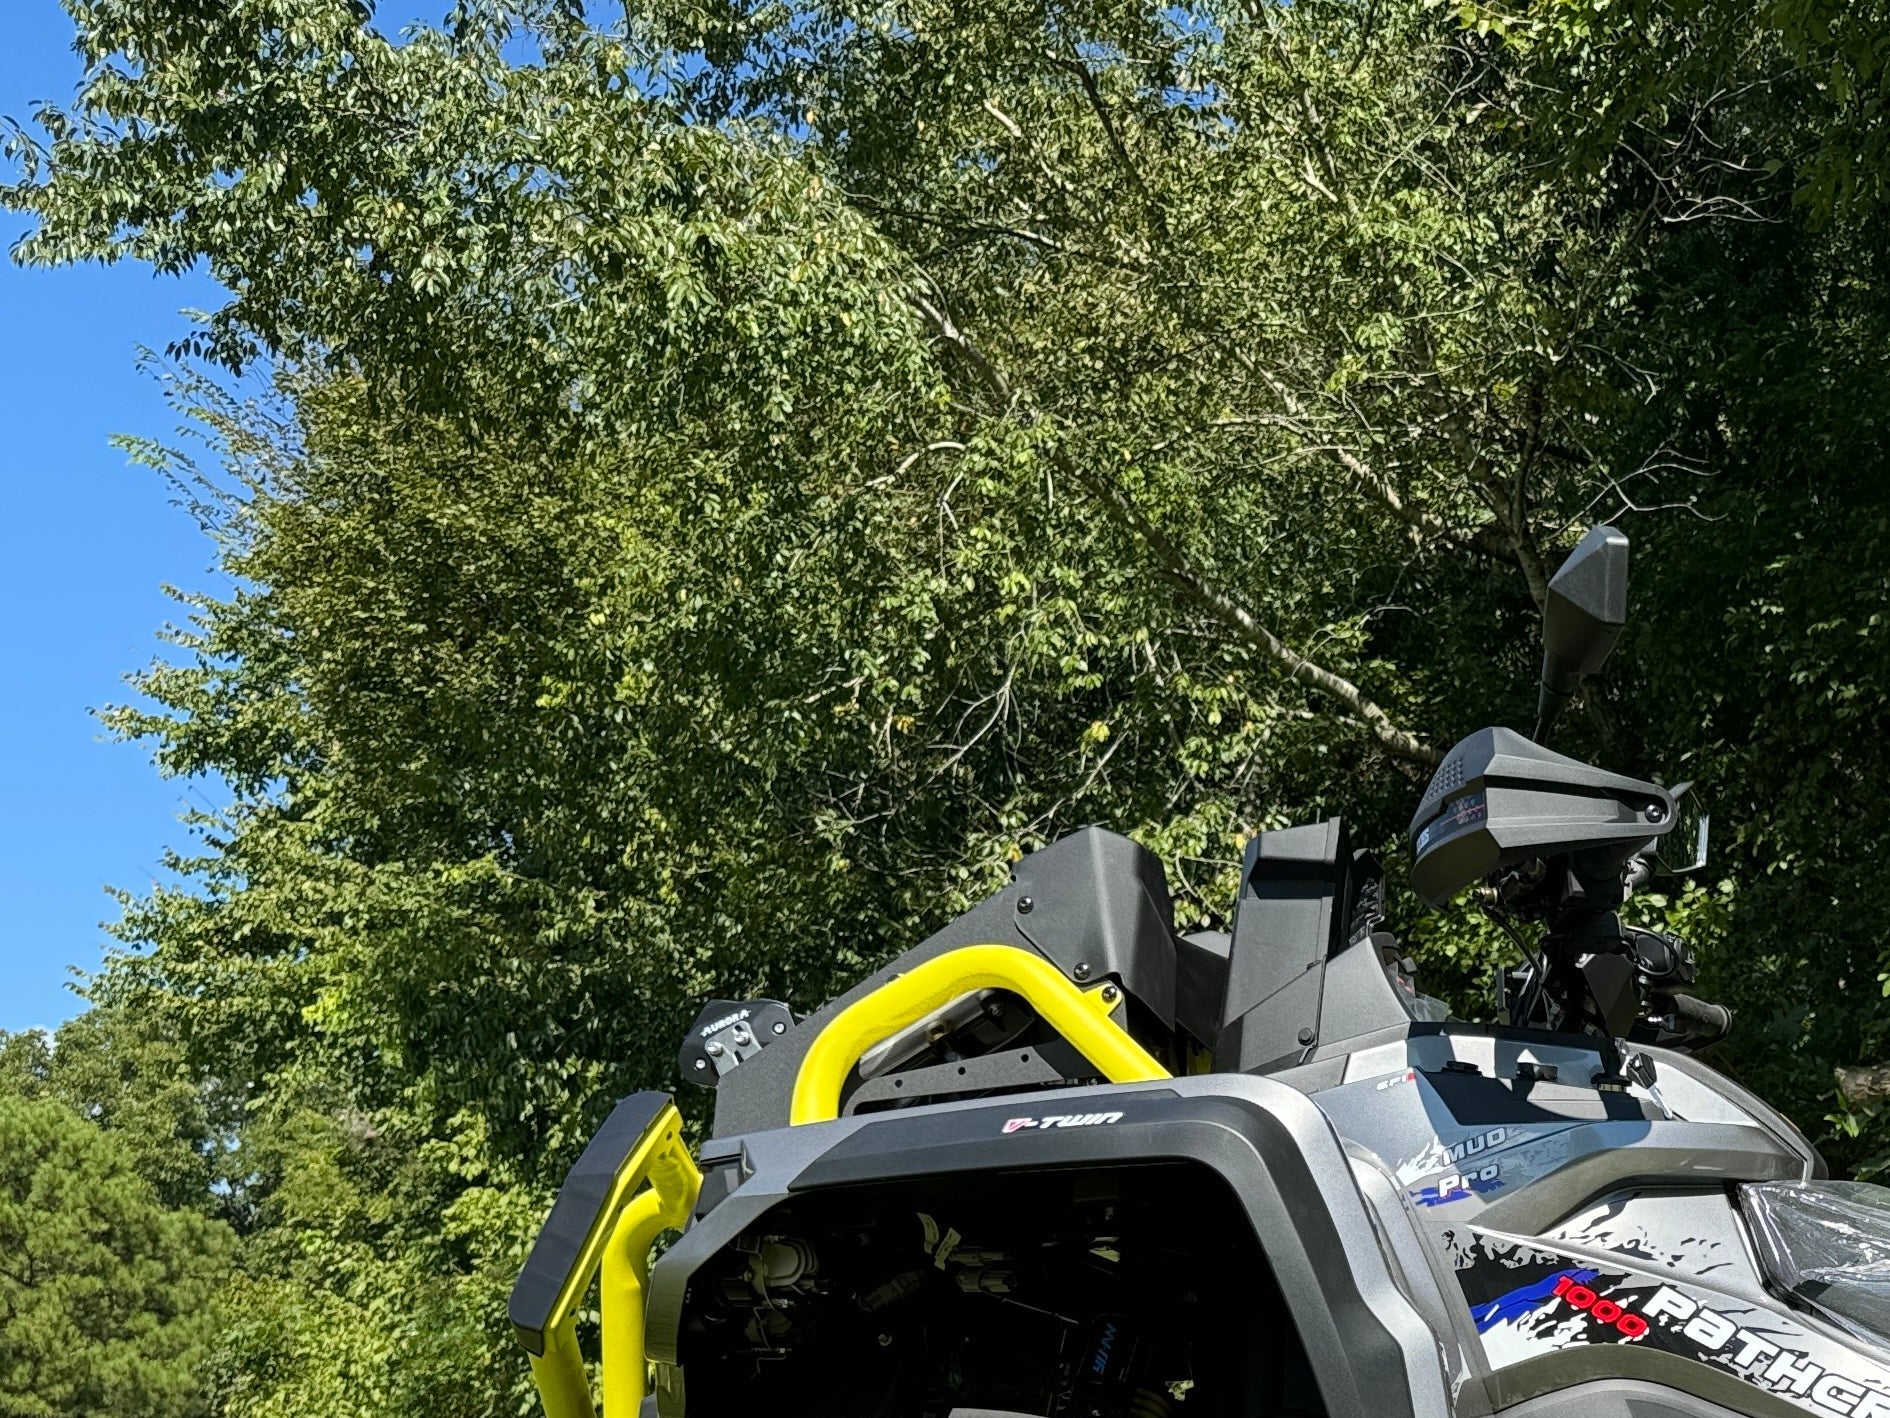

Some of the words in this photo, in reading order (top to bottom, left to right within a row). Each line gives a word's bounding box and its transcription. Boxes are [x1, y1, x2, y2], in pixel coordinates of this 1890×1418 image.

[700, 1009, 751, 1037] AURORA
[1442, 1127, 1506, 1166] MUD
[1552, 1275, 1649, 1337] 1000
